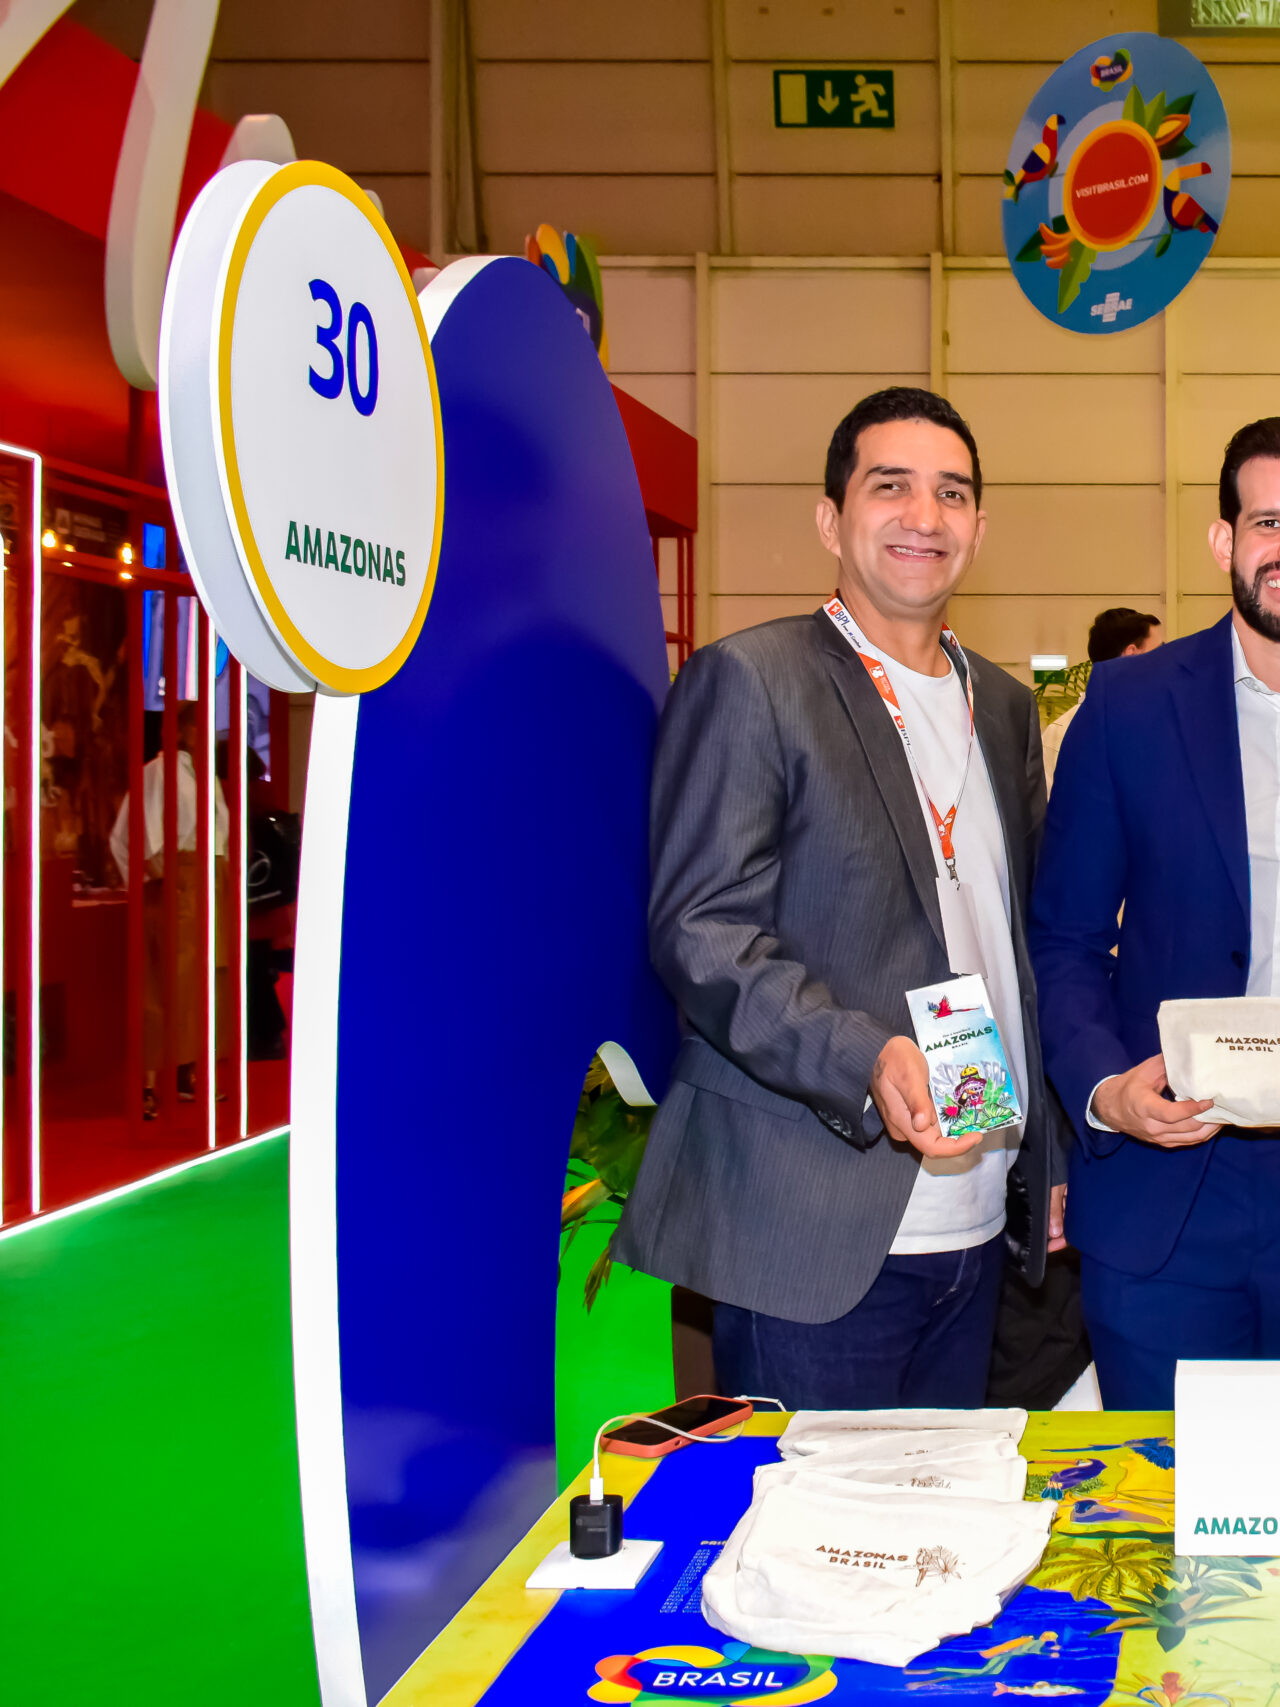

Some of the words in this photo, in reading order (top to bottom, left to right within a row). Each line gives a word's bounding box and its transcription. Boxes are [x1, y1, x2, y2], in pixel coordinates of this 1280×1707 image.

[1075, 173, 1149, 199] VISITBRASIL.COM
[1090, 297, 1134, 317] SEBRAE
[308, 278, 380, 418] 30
[285, 520, 407, 587] AMAZONAS
[834, 611, 850, 626] BPI
[925, 1026, 993, 1053] AMAZONAS
[1229, 1045, 1274, 1053] BRASIL
[816, 1545, 908, 1562] AMAZONAS
[829, 1556, 886, 1569] BRASIL
[652, 1671, 784, 1688] BRASIL
